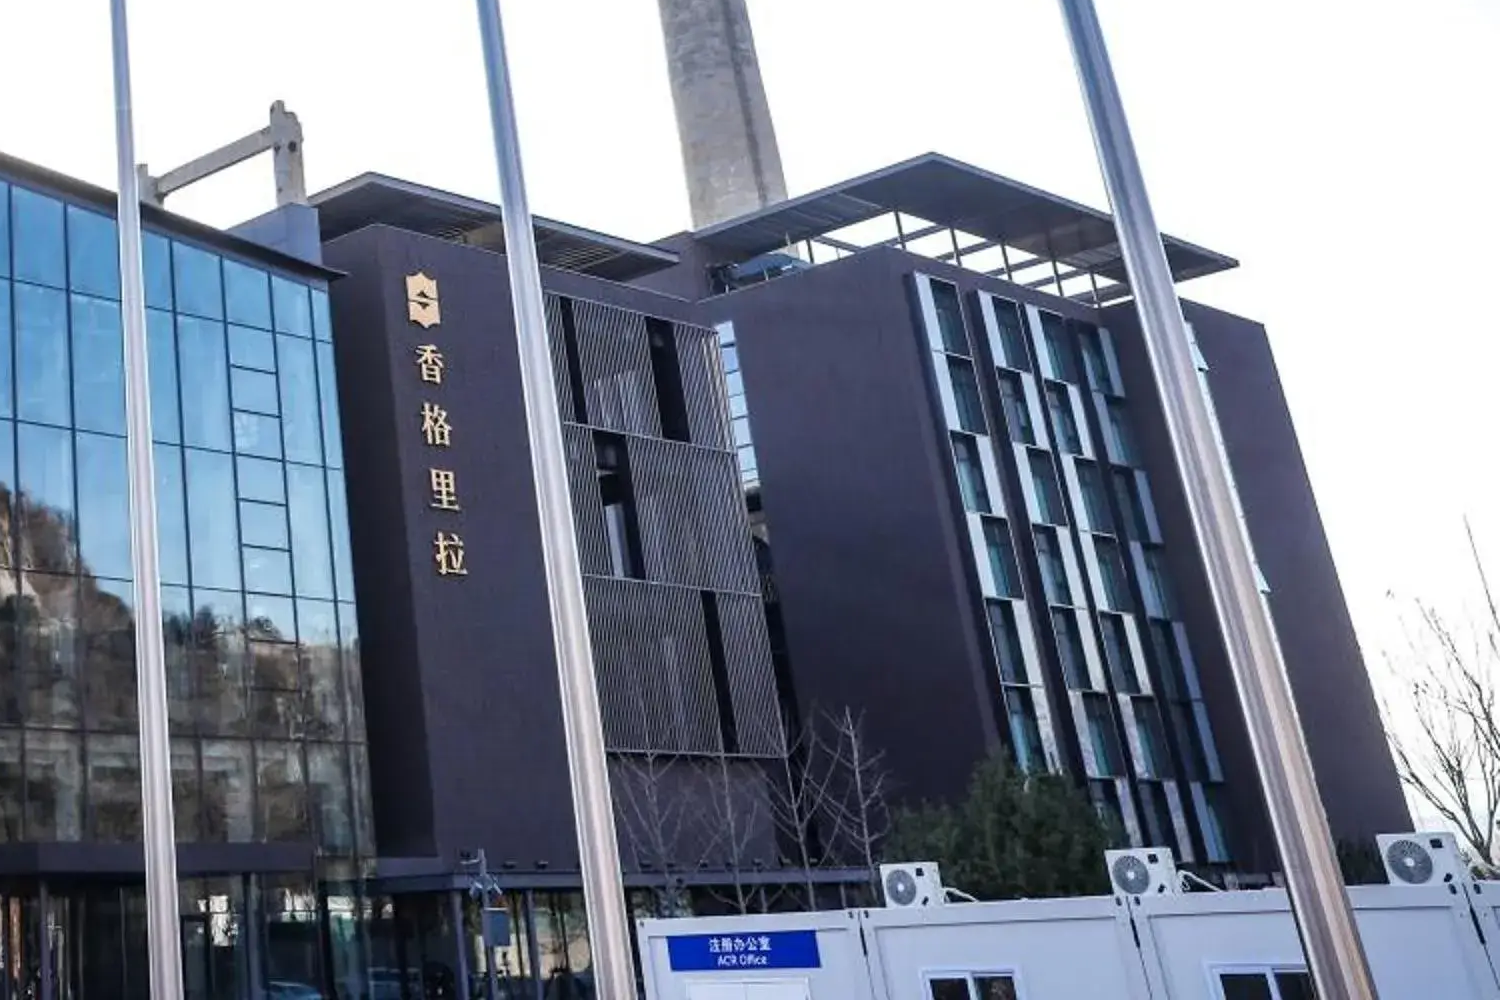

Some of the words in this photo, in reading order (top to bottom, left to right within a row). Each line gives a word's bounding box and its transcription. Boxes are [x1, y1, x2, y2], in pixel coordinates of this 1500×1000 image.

[415, 344, 468, 575] 香格里拉
[739, 953, 767, 965] Office
